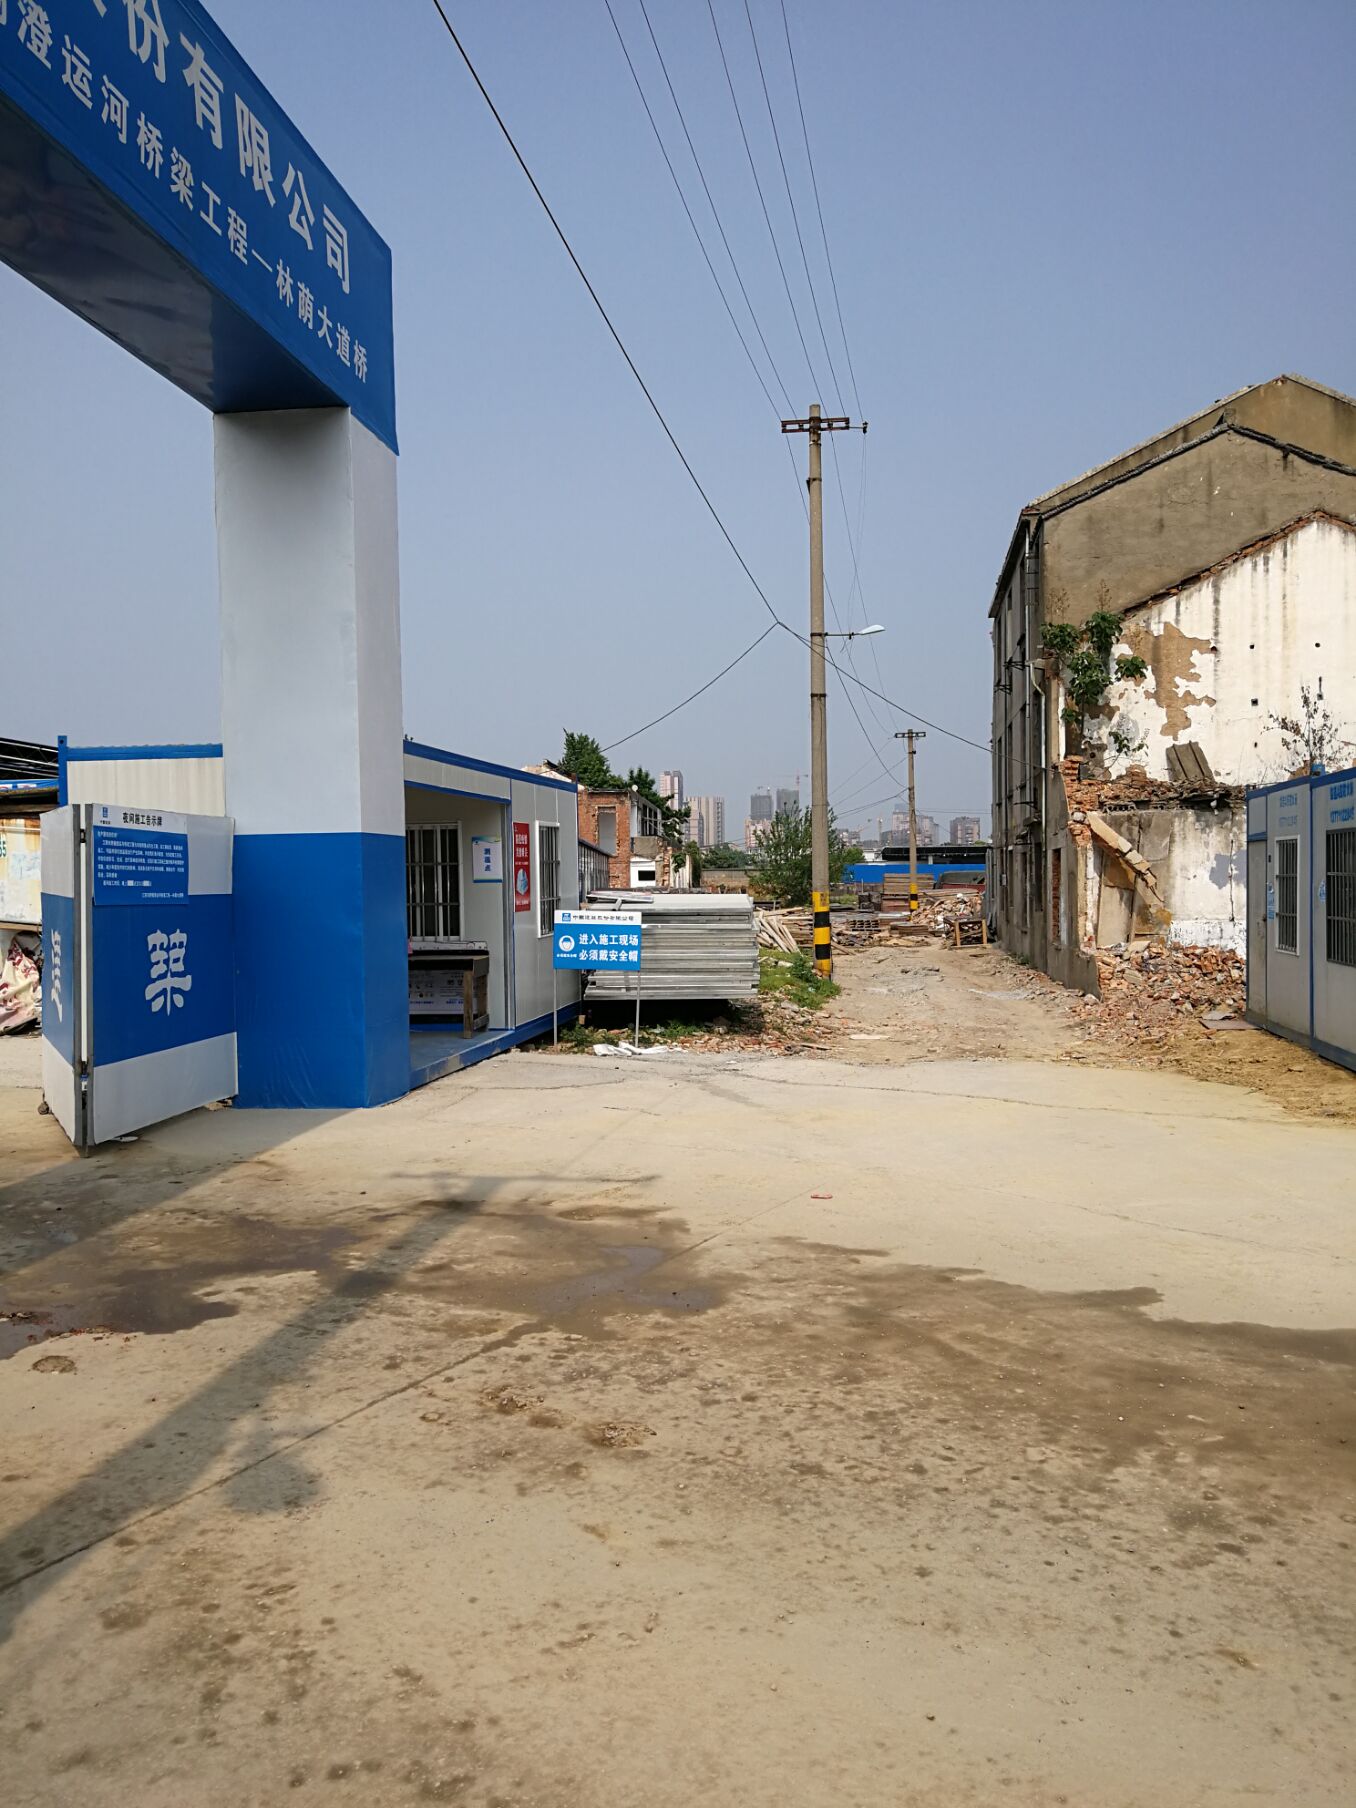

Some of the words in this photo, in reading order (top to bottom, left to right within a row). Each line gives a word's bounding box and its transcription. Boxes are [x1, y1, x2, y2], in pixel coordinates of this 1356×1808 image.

[579, 933, 638, 946] 进入施工现场
[579, 949, 638, 962] 必须戴安全帽
